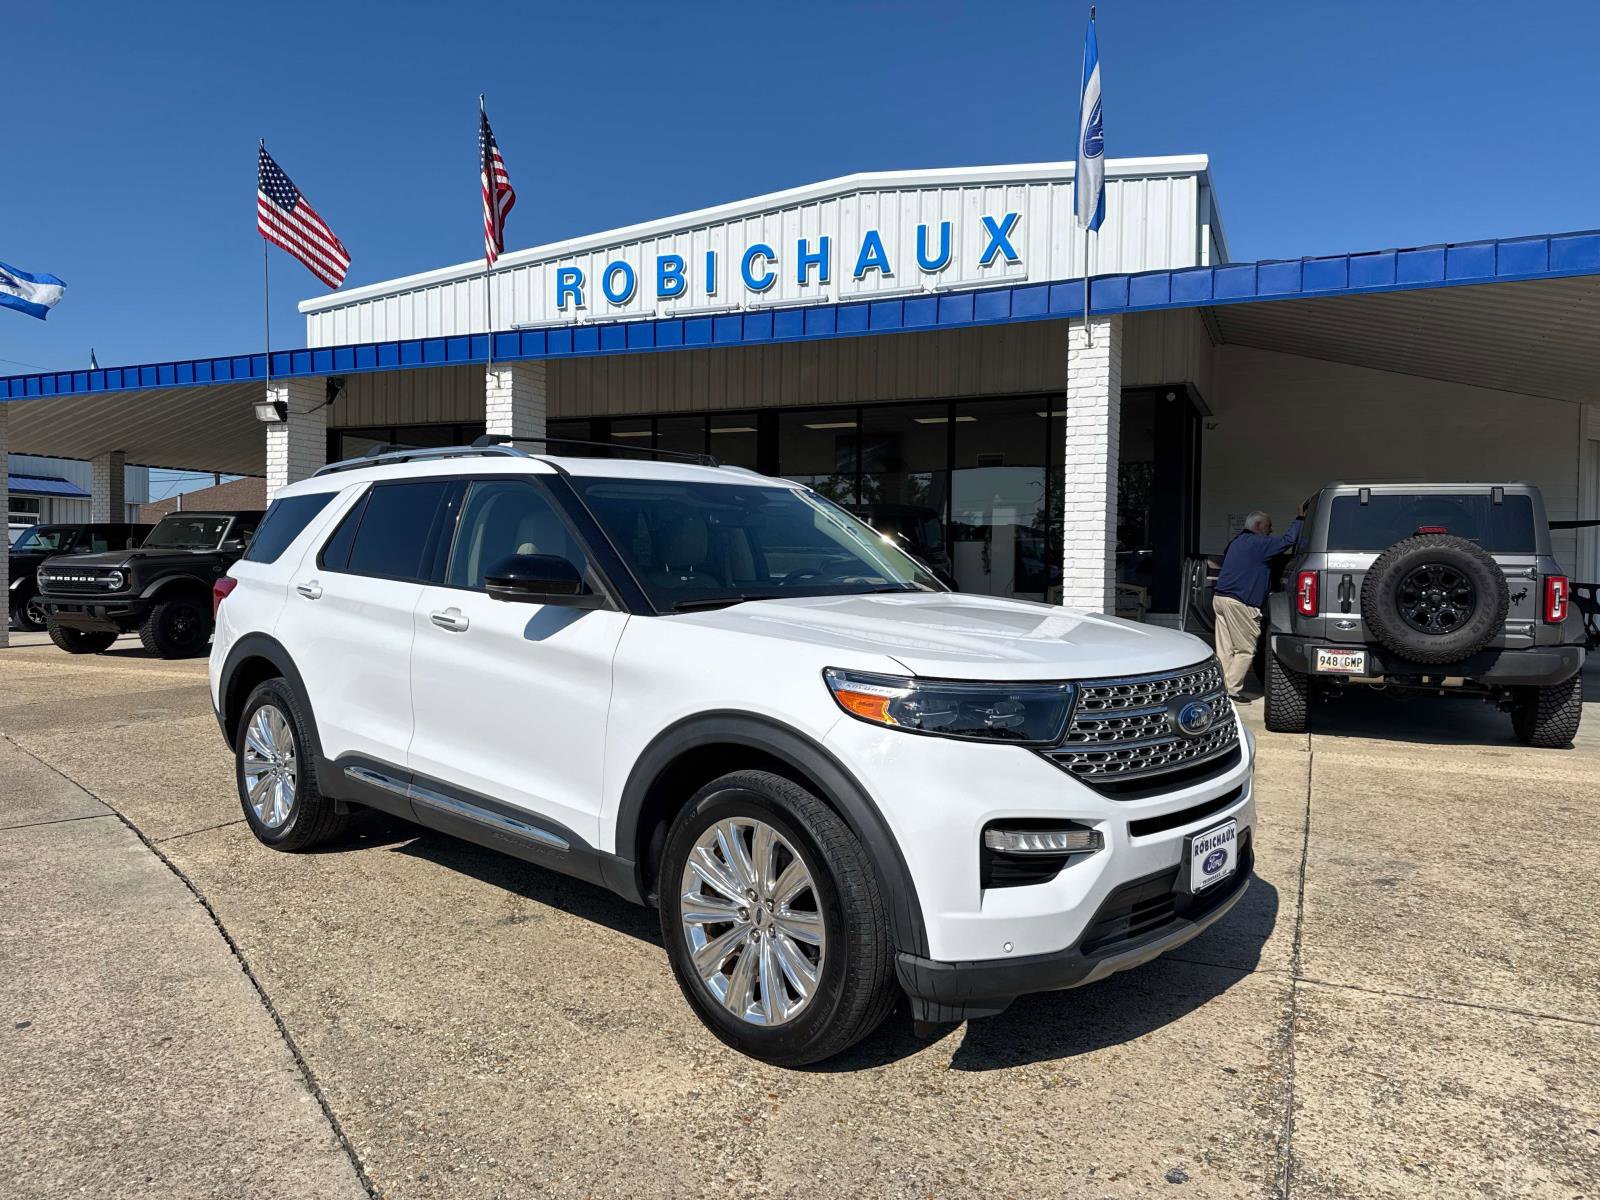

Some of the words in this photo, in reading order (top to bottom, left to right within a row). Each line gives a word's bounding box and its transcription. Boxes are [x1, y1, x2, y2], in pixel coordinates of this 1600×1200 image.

[556, 211, 1020, 309] ROBICHAUX
[1320, 655, 1338, 667] 948
[1344, 657, 1363, 668] GMP
[1195, 828, 1235, 857] ROBICHAUX
